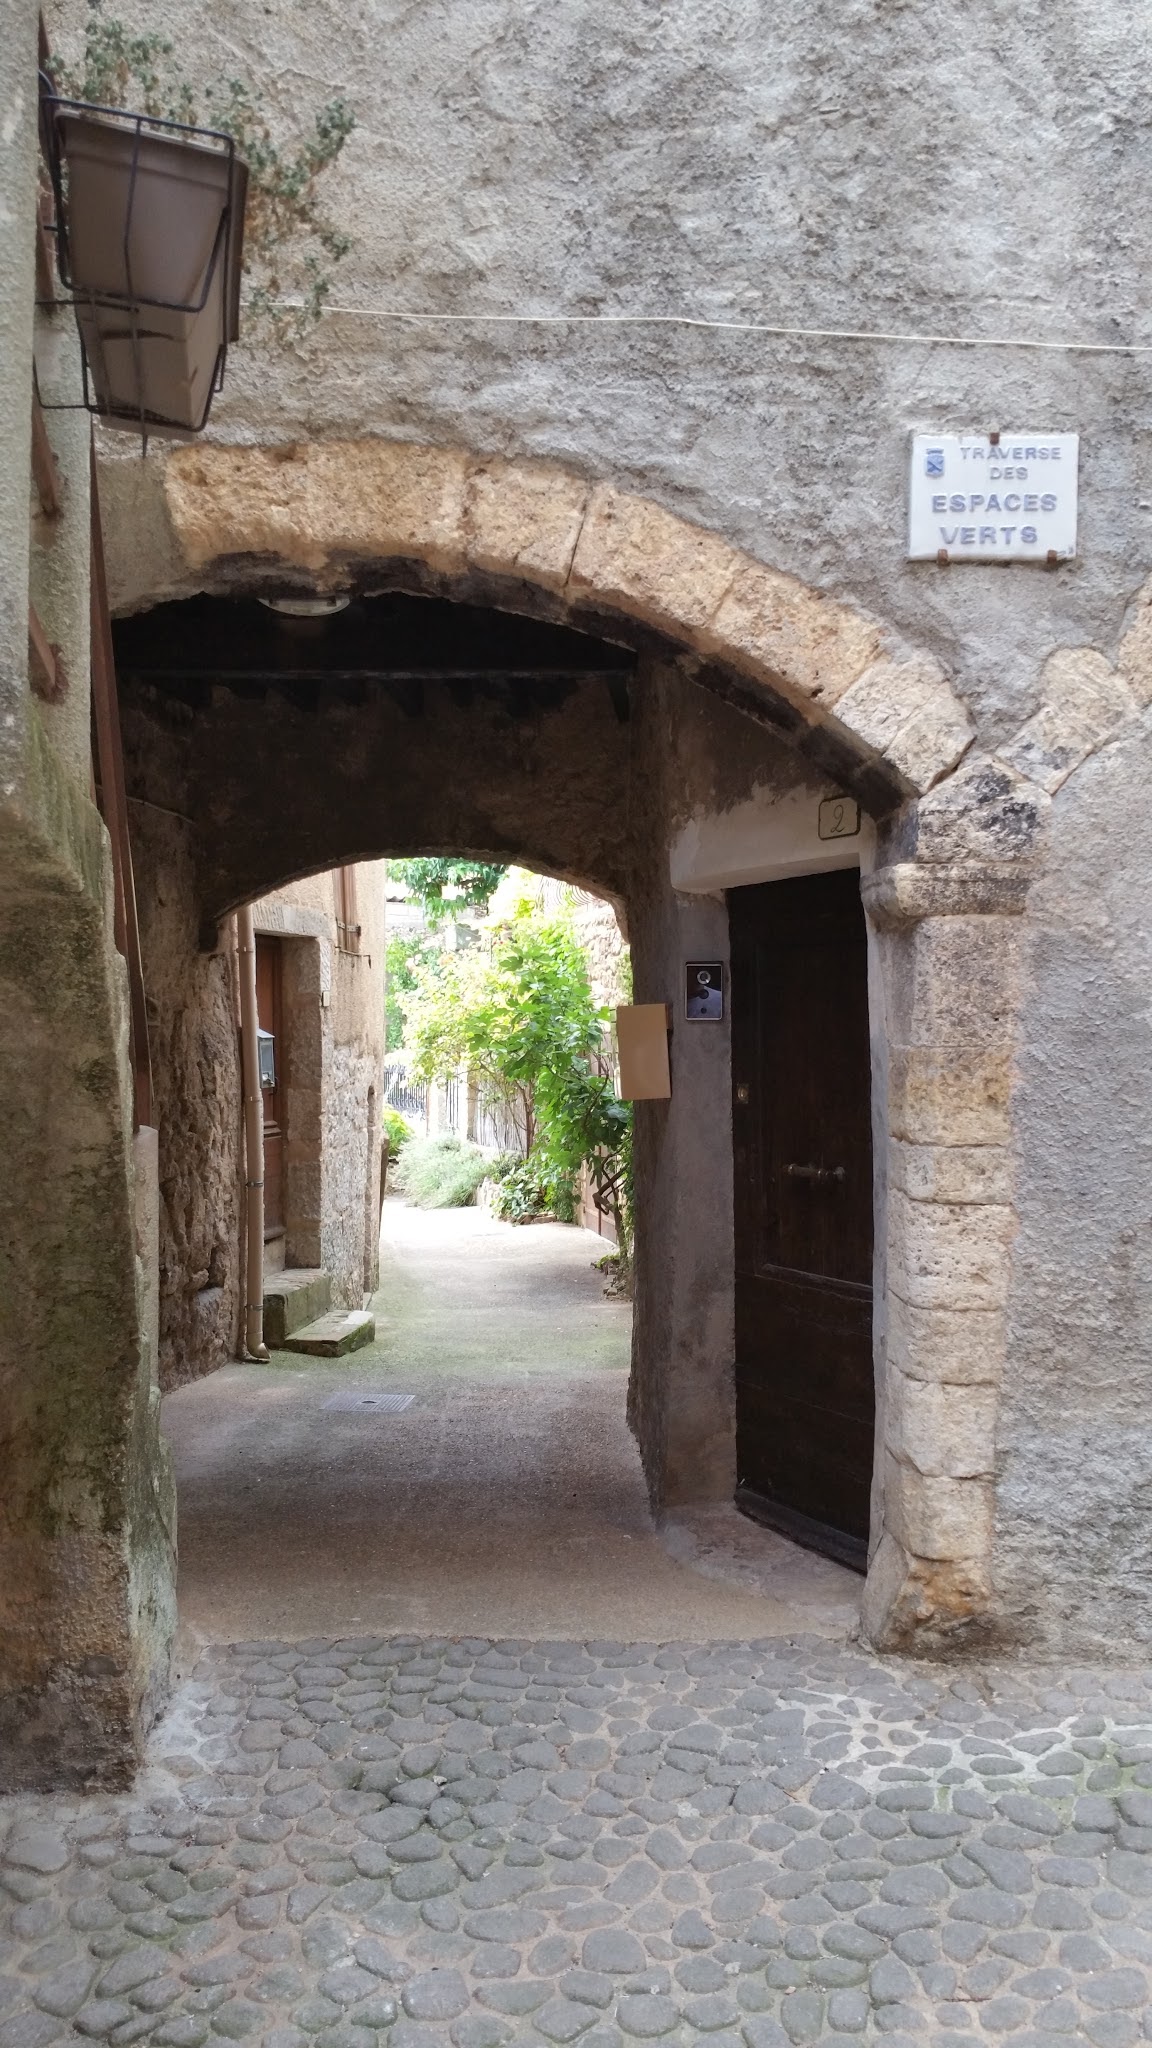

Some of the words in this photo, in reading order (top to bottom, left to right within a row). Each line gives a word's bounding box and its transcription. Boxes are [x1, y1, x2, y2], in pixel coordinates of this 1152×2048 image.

[960, 447, 1062, 460] TRAVERSE
[990, 467, 1028, 480] DES
[931, 494, 1058, 513] ESPACES
[939, 526, 1038, 545] VERTS
[830, 804, 846, 833] 2
